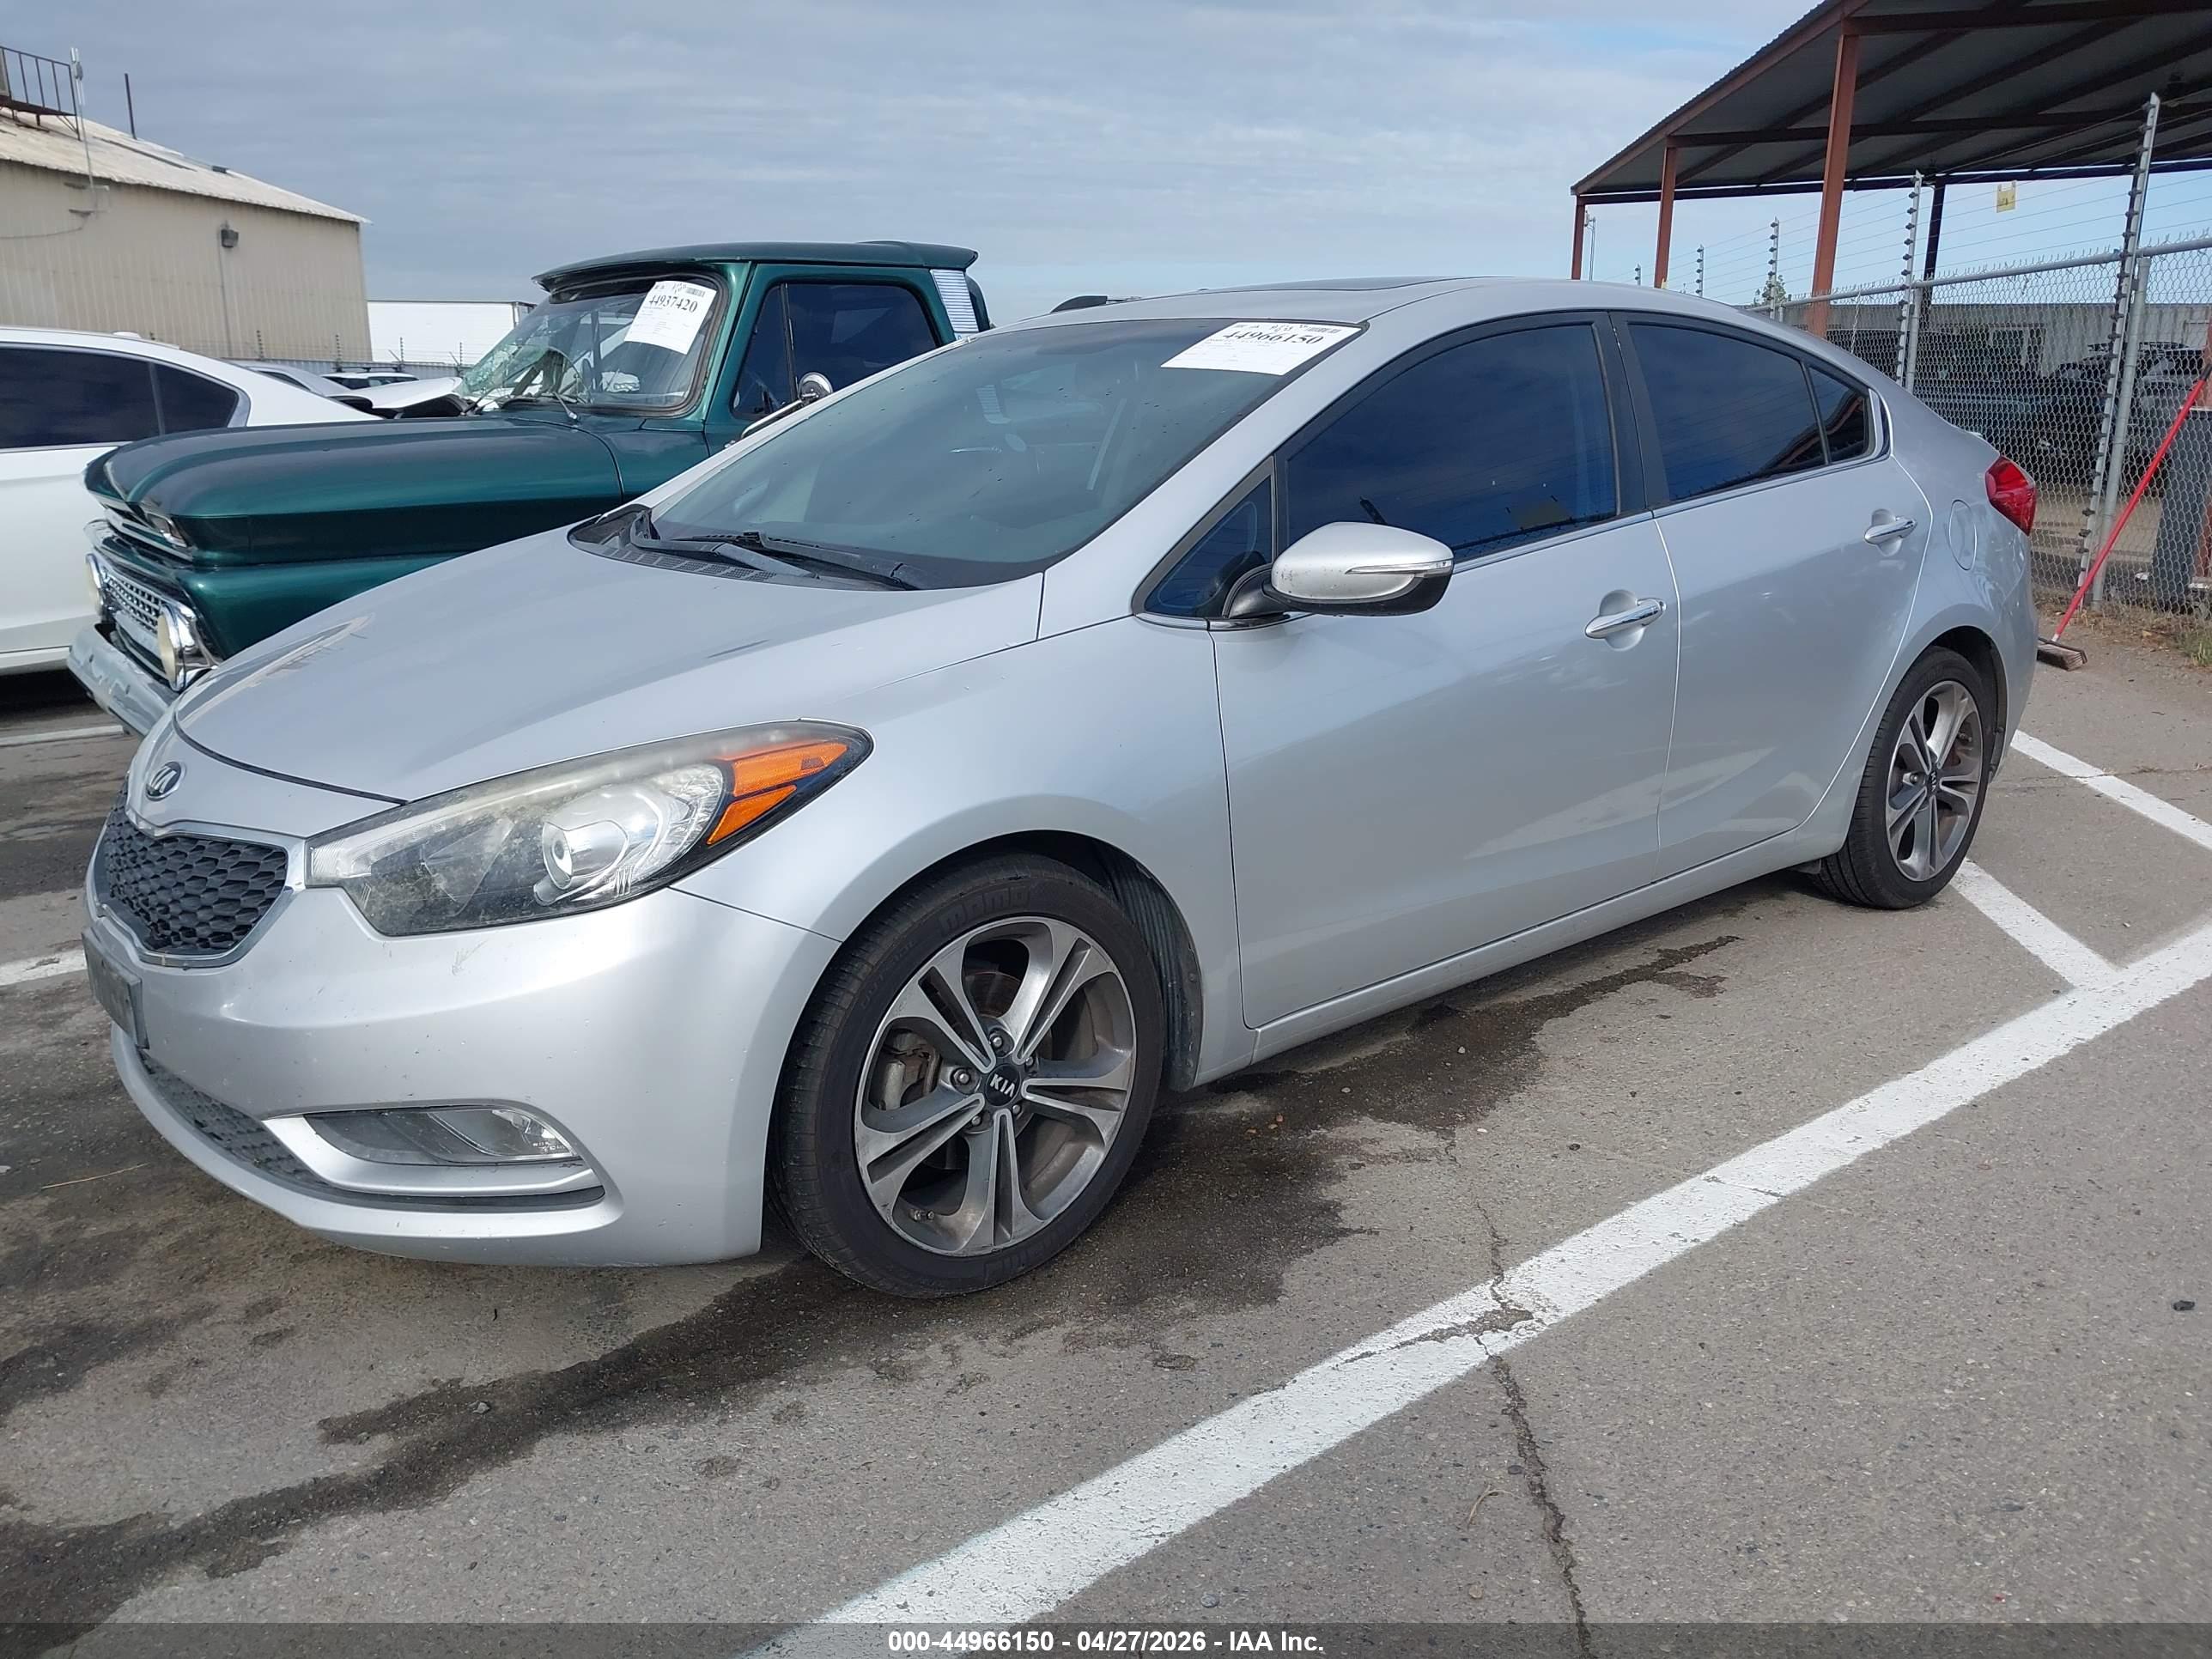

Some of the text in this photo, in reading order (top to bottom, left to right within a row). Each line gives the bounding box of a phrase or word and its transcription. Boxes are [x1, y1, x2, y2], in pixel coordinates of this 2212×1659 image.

[648, 295, 698, 313] 44937420
[1223, 331, 1324, 344] 44966150
[989, 1073, 1016, 1098] KIA
